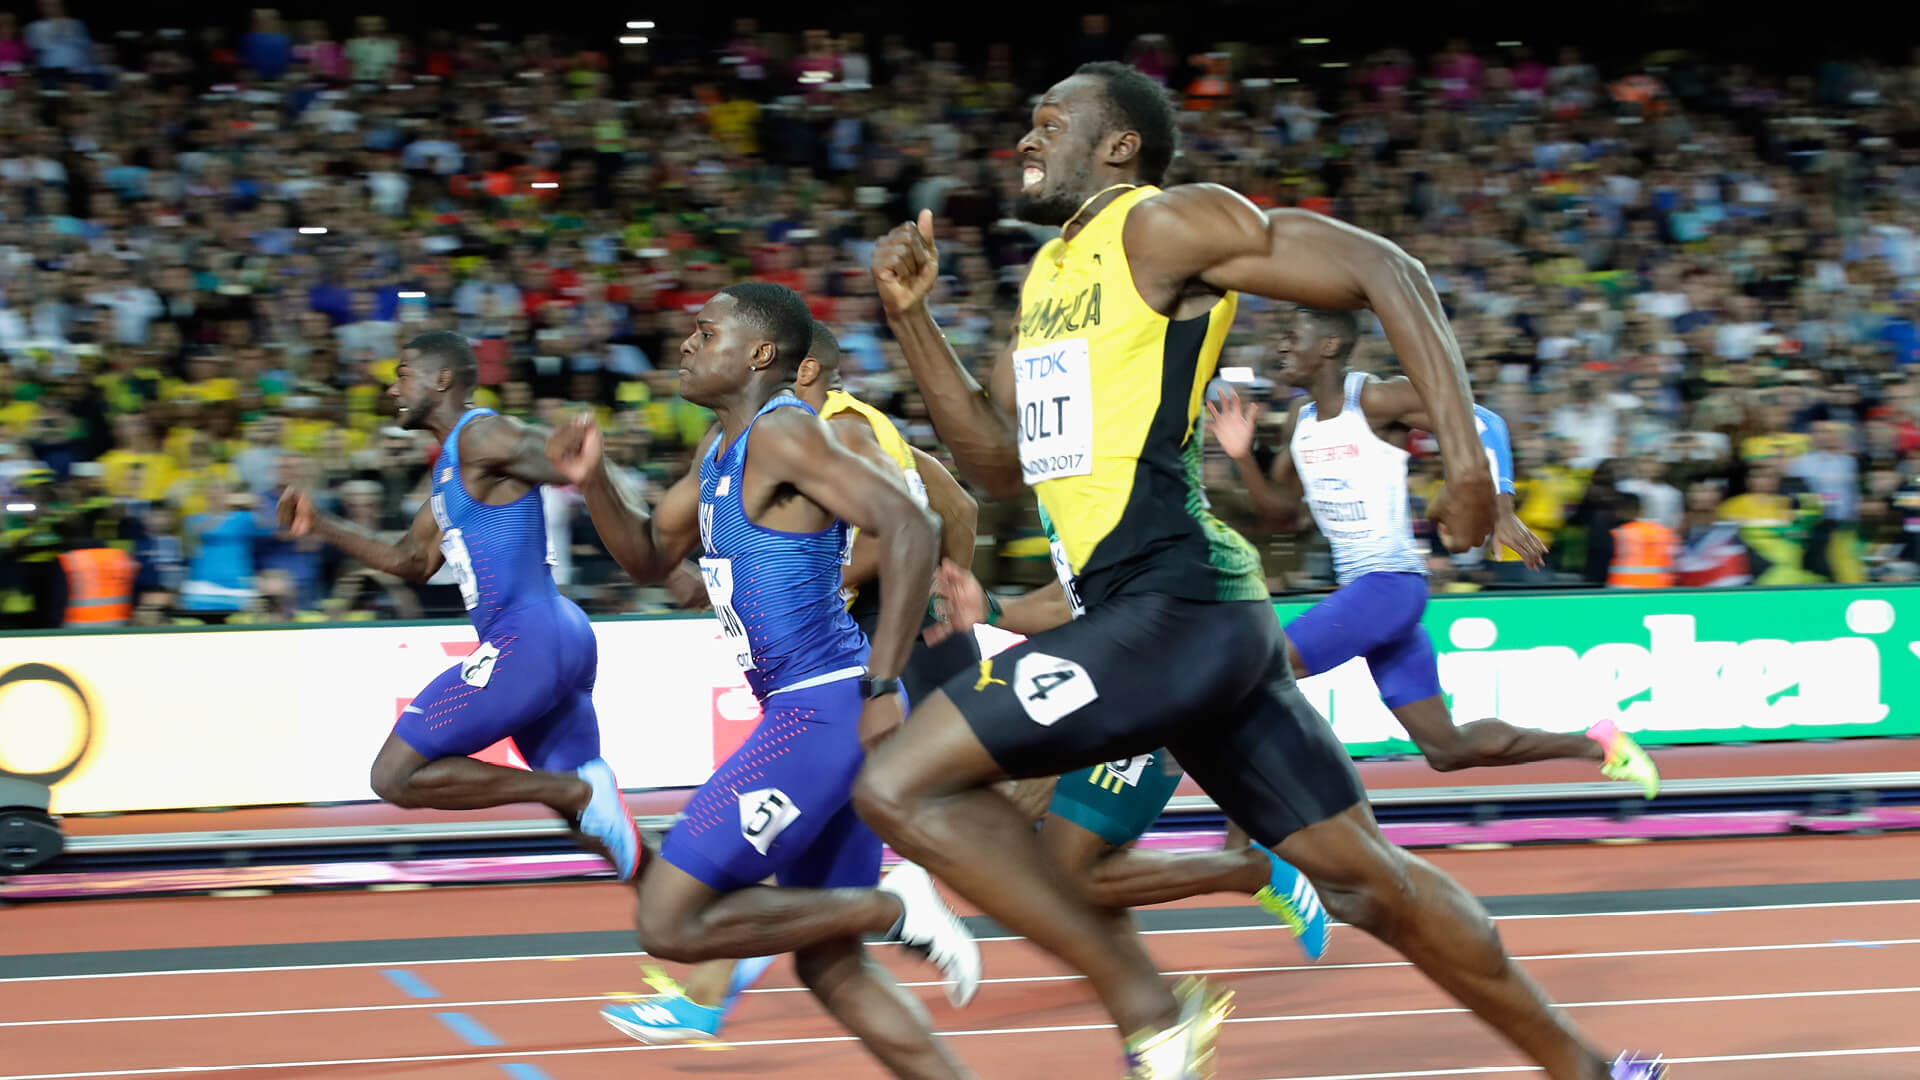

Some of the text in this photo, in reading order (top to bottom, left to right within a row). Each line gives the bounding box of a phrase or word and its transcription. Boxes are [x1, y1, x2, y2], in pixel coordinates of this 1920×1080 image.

[1024, 349, 1068, 380] TDK
[1049, 454, 1084, 471] 2017
[1027, 668, 1076, 702] 4
[746, 793, 785, 837] 5
